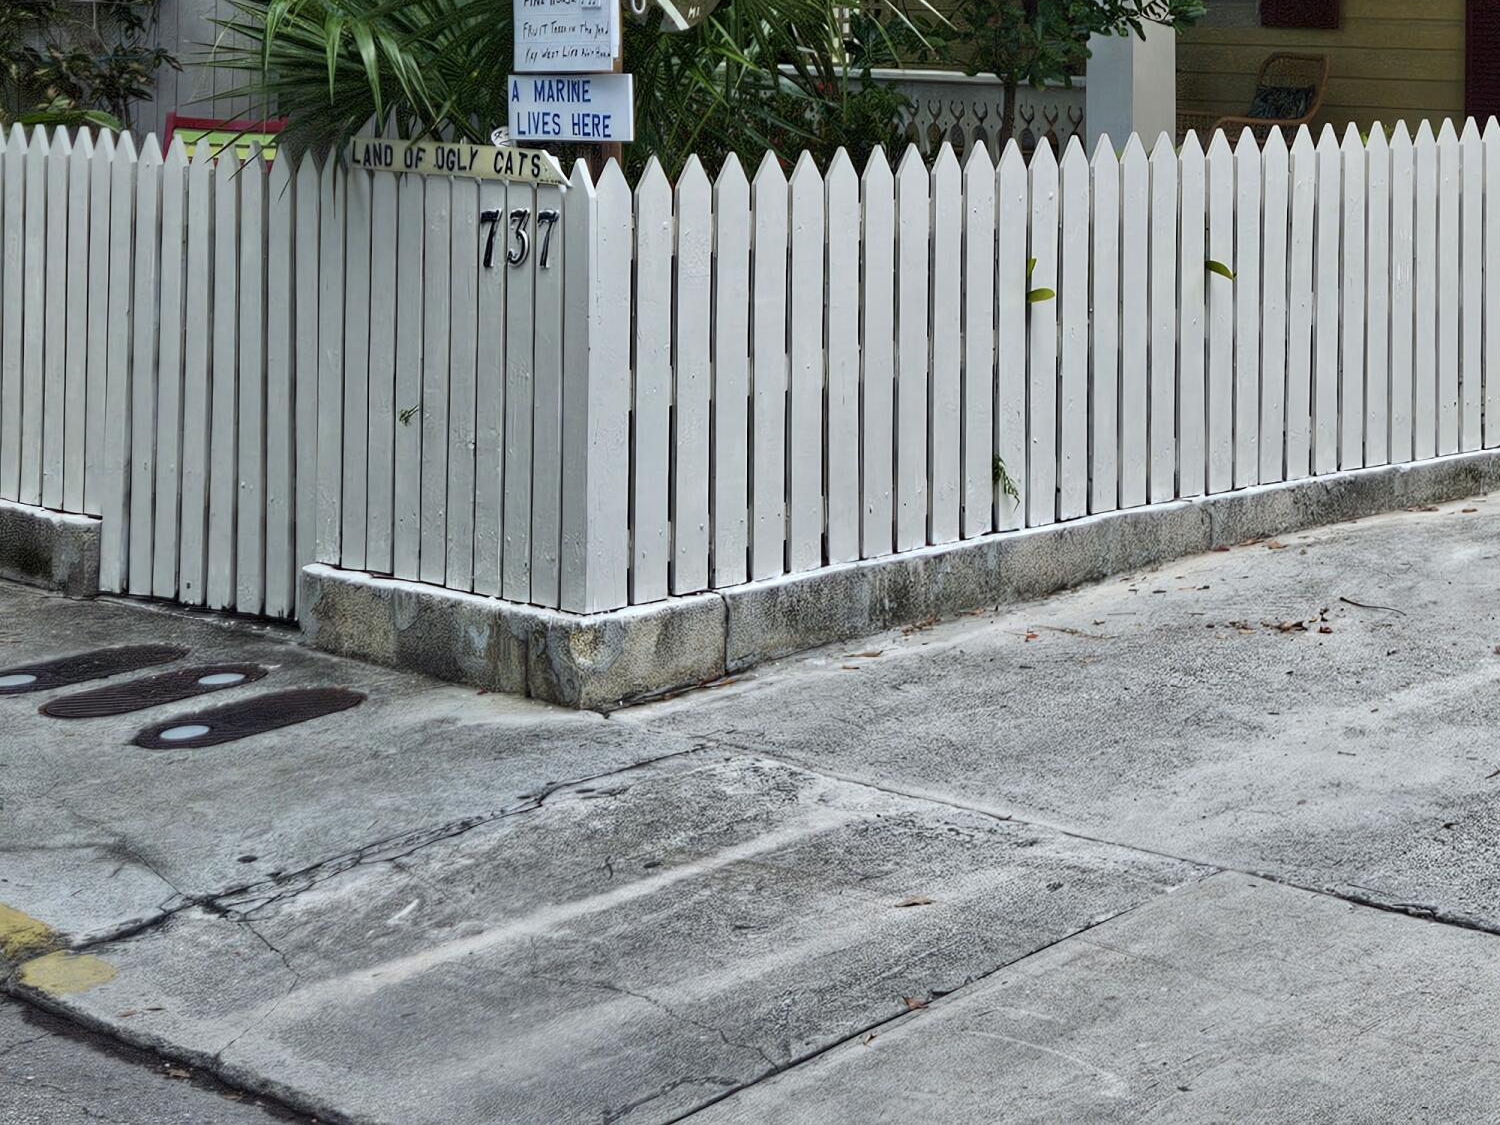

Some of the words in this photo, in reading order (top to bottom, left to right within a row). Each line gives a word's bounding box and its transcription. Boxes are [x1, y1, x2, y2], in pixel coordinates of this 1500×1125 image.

[511, 80, 520, 103] A
[534, 79, 592, 103] MARINE
[516, 112, 561, 136] LIVES
[572, 112, 612, 138] HERE
[351, 139, 394, 167] LAND
[403, 148, 426, 169] OF
[435, 145, 478, 172] UGLY
[493, 150, 541, 178] CATS
[480, 208, 560, 268] 737
